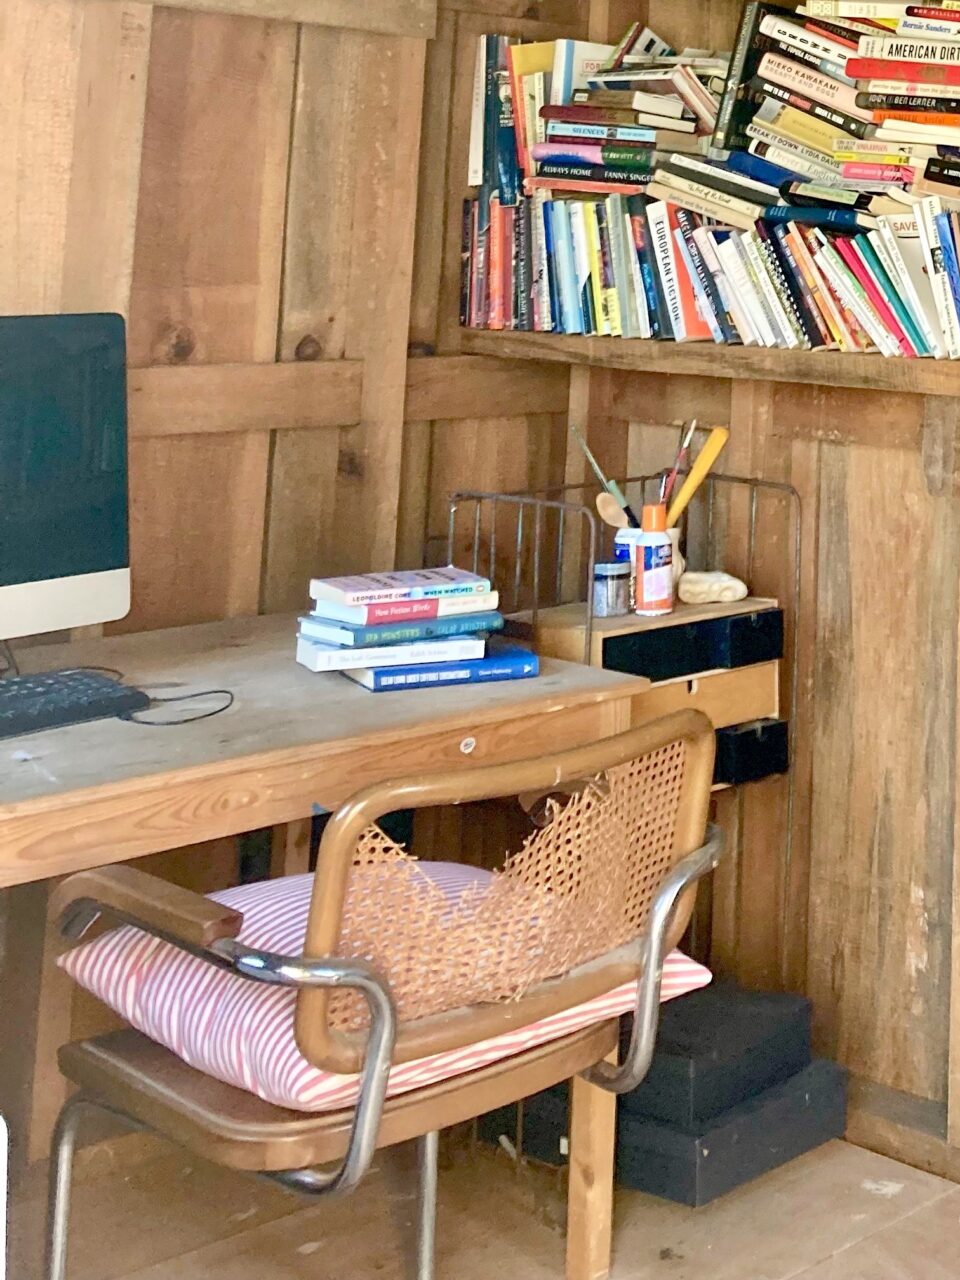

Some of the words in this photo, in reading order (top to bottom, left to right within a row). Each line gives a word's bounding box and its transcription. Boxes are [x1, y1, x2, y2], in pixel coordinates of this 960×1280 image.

[902, 19, 924, 30] Bernie
[925, 22, 951, 33] Sanders
[887, 43, 937, 59] AMERICAN
[767, 58, 793, 73] MIEKO
[794, 69, 840, 93] KAWAKAMI
[894, 95, 908, 104] BEN
[908, 96, 936, 108] LERNER
[572, 127, 605, 136] SILENCES
[749, 126, 769, 140] BREAK
[770, 135, 778, 143] IT
[777, 137, 800, 149] DOWN
[801, 148, 820, 160] LYDIA
[821, 154, 840, 169] DAVIS
[543, 165, 569, 175] ALWAYS
[570, 167, 592, 177] HOME
[604, 171, 628, 181] FANNY
[893, 221, 917, 231] SAVE
[655, 220, 673, 276] EUROPEAN
[667, 273, 680, 322] FICTION
